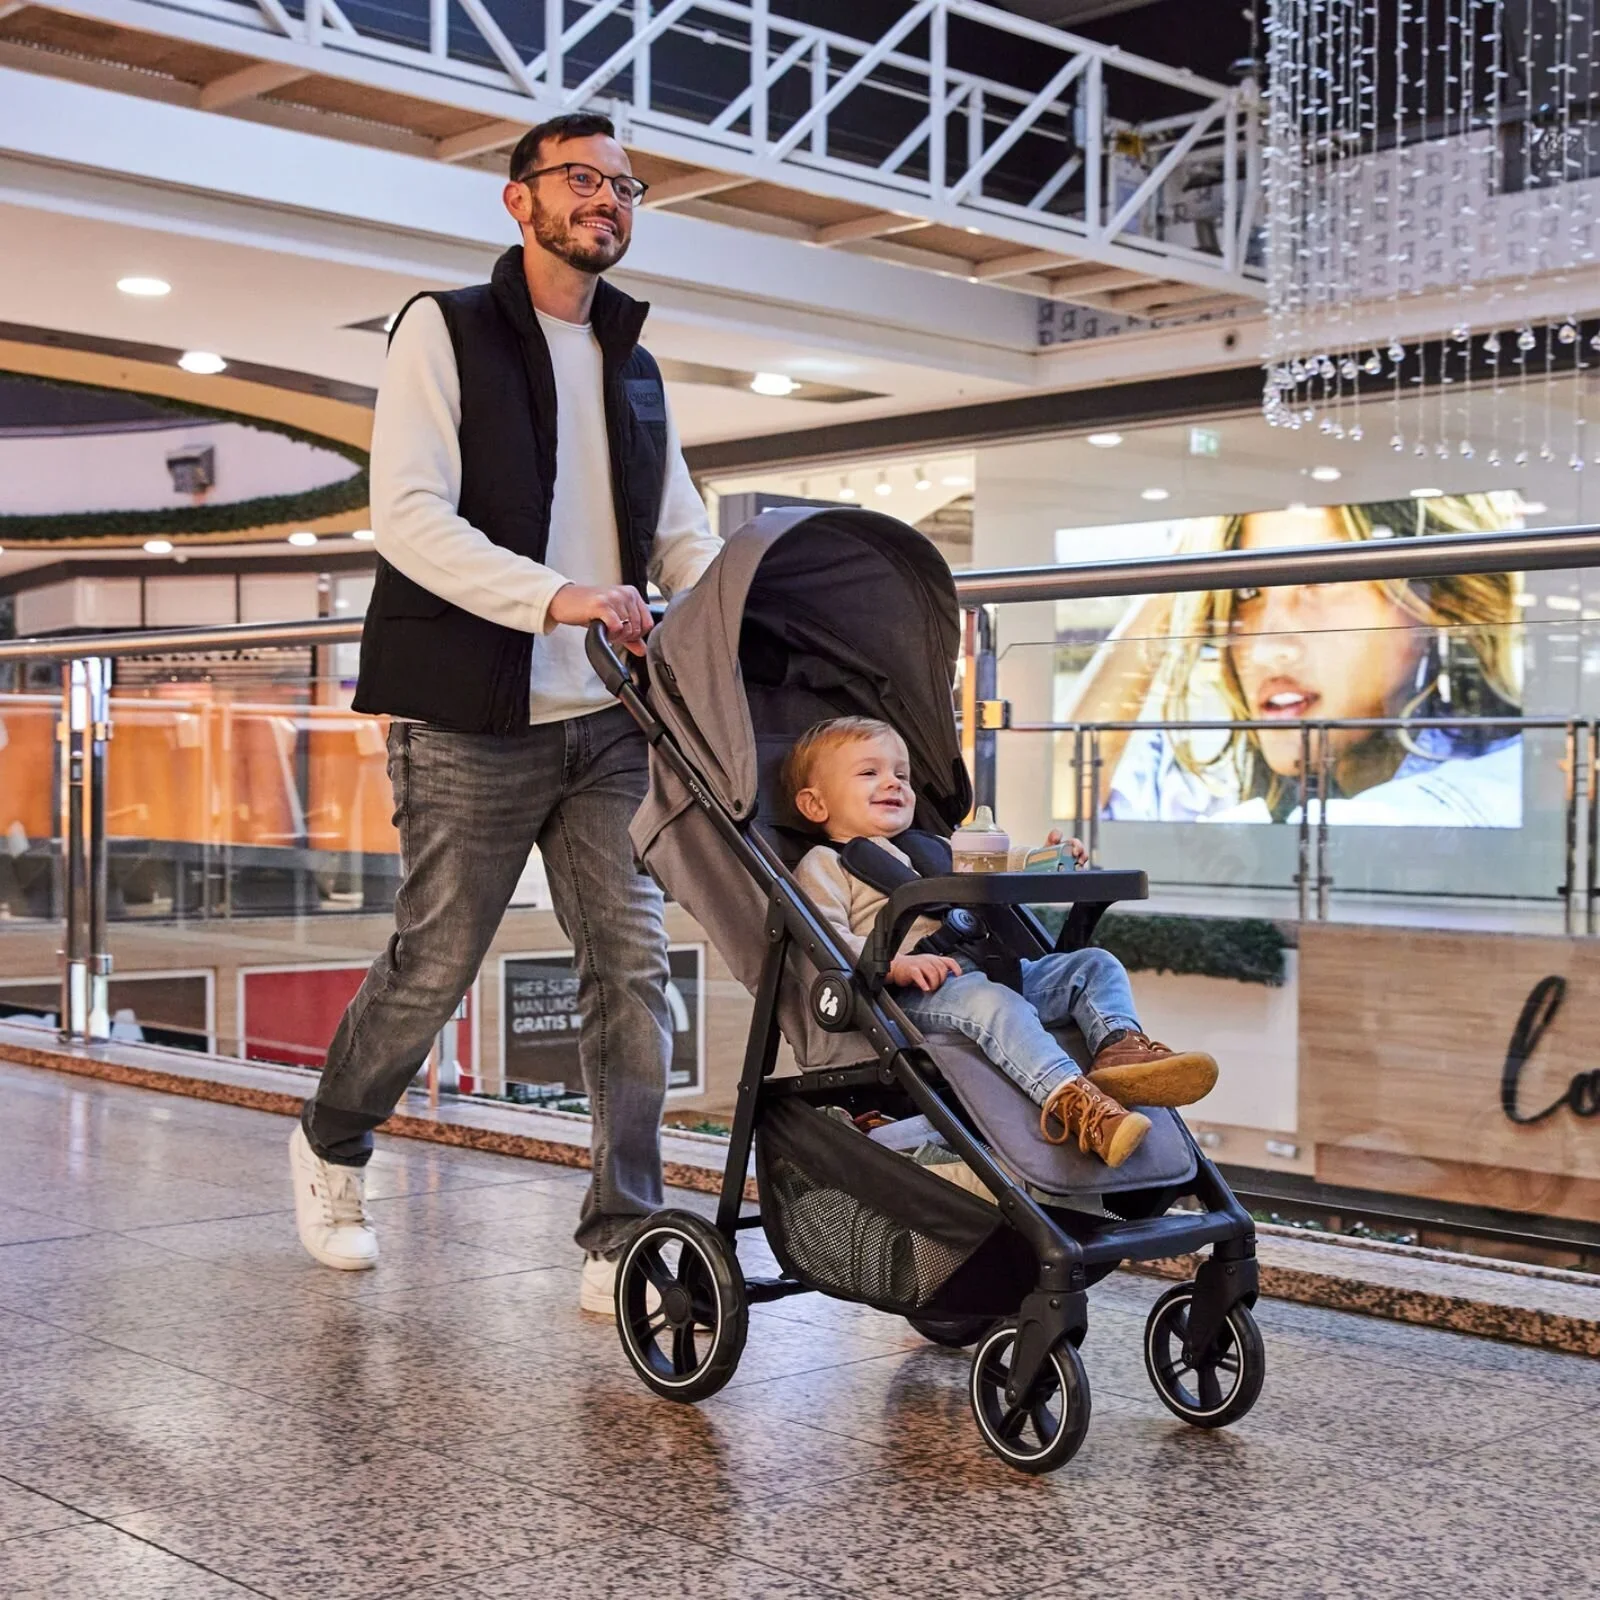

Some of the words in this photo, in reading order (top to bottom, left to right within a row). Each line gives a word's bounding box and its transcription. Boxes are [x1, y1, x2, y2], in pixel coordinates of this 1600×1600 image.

[513, 981, 545, 997] HIER
[513, 999, 545, 1014] MAN
[512, 1014, 568, 1033] GRATIS
